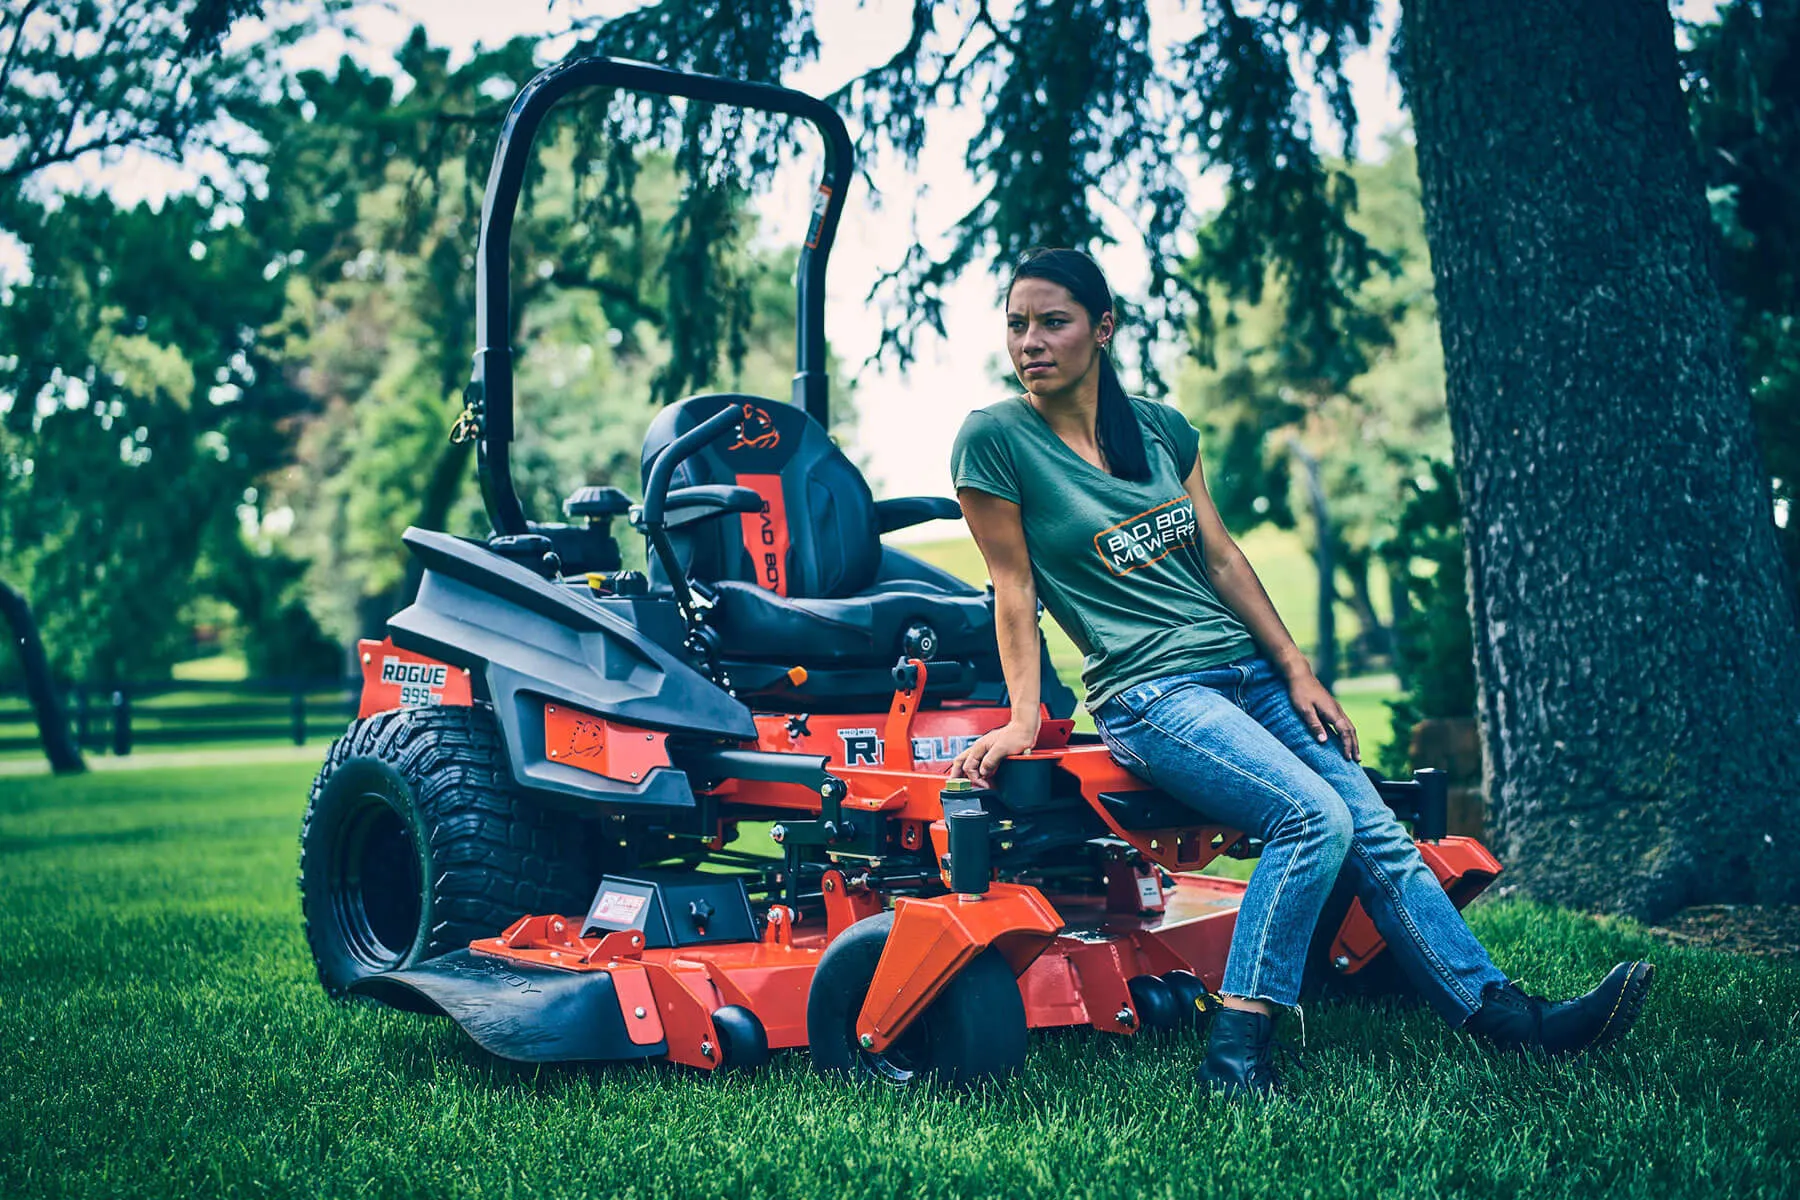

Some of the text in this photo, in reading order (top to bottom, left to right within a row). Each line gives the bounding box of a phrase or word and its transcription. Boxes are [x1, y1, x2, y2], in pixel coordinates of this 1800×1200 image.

[1107, 503, 1193, 552] BAD BOY
[1113, 520, 1195, 566] MOWERS
[382, 664, 447, 685] ROGUE
[401, 687, 429, 705] 999
